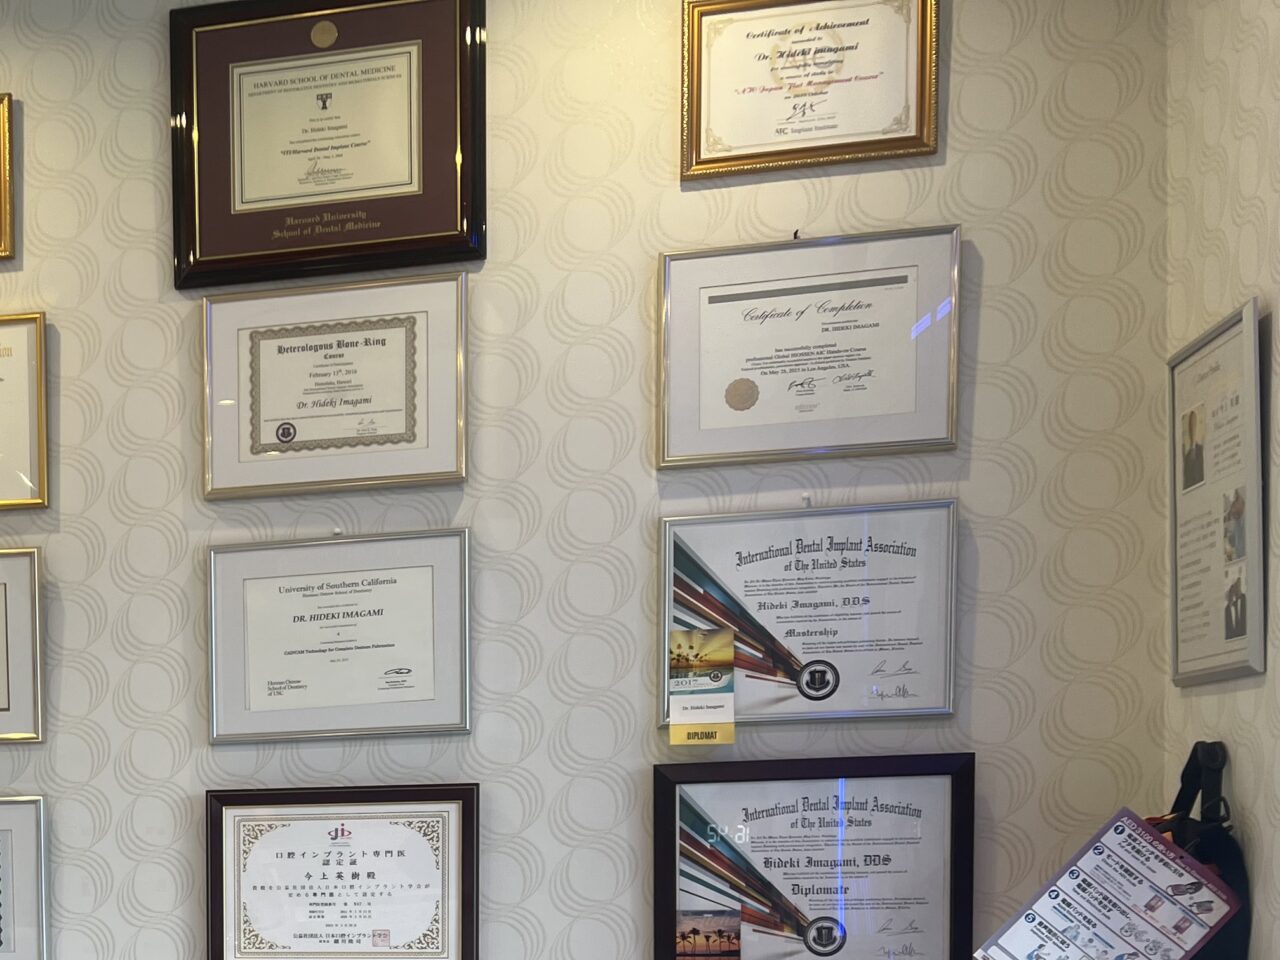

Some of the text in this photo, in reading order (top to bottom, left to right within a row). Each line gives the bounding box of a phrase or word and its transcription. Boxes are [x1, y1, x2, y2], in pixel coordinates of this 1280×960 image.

[254, 65, 396, 89] HARVARD SCHOOL OF DENTAL MEDICINE
[285, 211, 367, 226] Harvard University
[272, 229, 301, 240] School
[315, 224, 341, 234] Dental
[344, 221, 381, 232] Medicine
[742, 299, 873, 325] Certificate of Completion
[277, 343, 333, 355] Heterologous
[297, 401, 308, 409] Dr.
[339, 396, 372, 408] Imagami
[735, 535, 917, 568] International Dental Implant Association
[783, 556, 867, 573] of The United States
[279, 584, 315, 594] University
[326, 581, 359, 590] Southern
[361, 577, 397, 587] California
[756, 600, 788, 612] Hideki
[293, 609, 384, 623] DR. HIDEKI IMAGAMI
[784, 627, 839, 640] Mastership
[674, 679, 698, 687] 2017
[686, 730, 718, 741] DIPLOMAT
[741, 794, 922, 825] International Dental Implant Association
[790, 815, 873, 831] of The United States
[763, 856, 801, 869] Hideki
[863, 854, 893, 867] DDS
[791, 883, 850, 898] Diplomate
